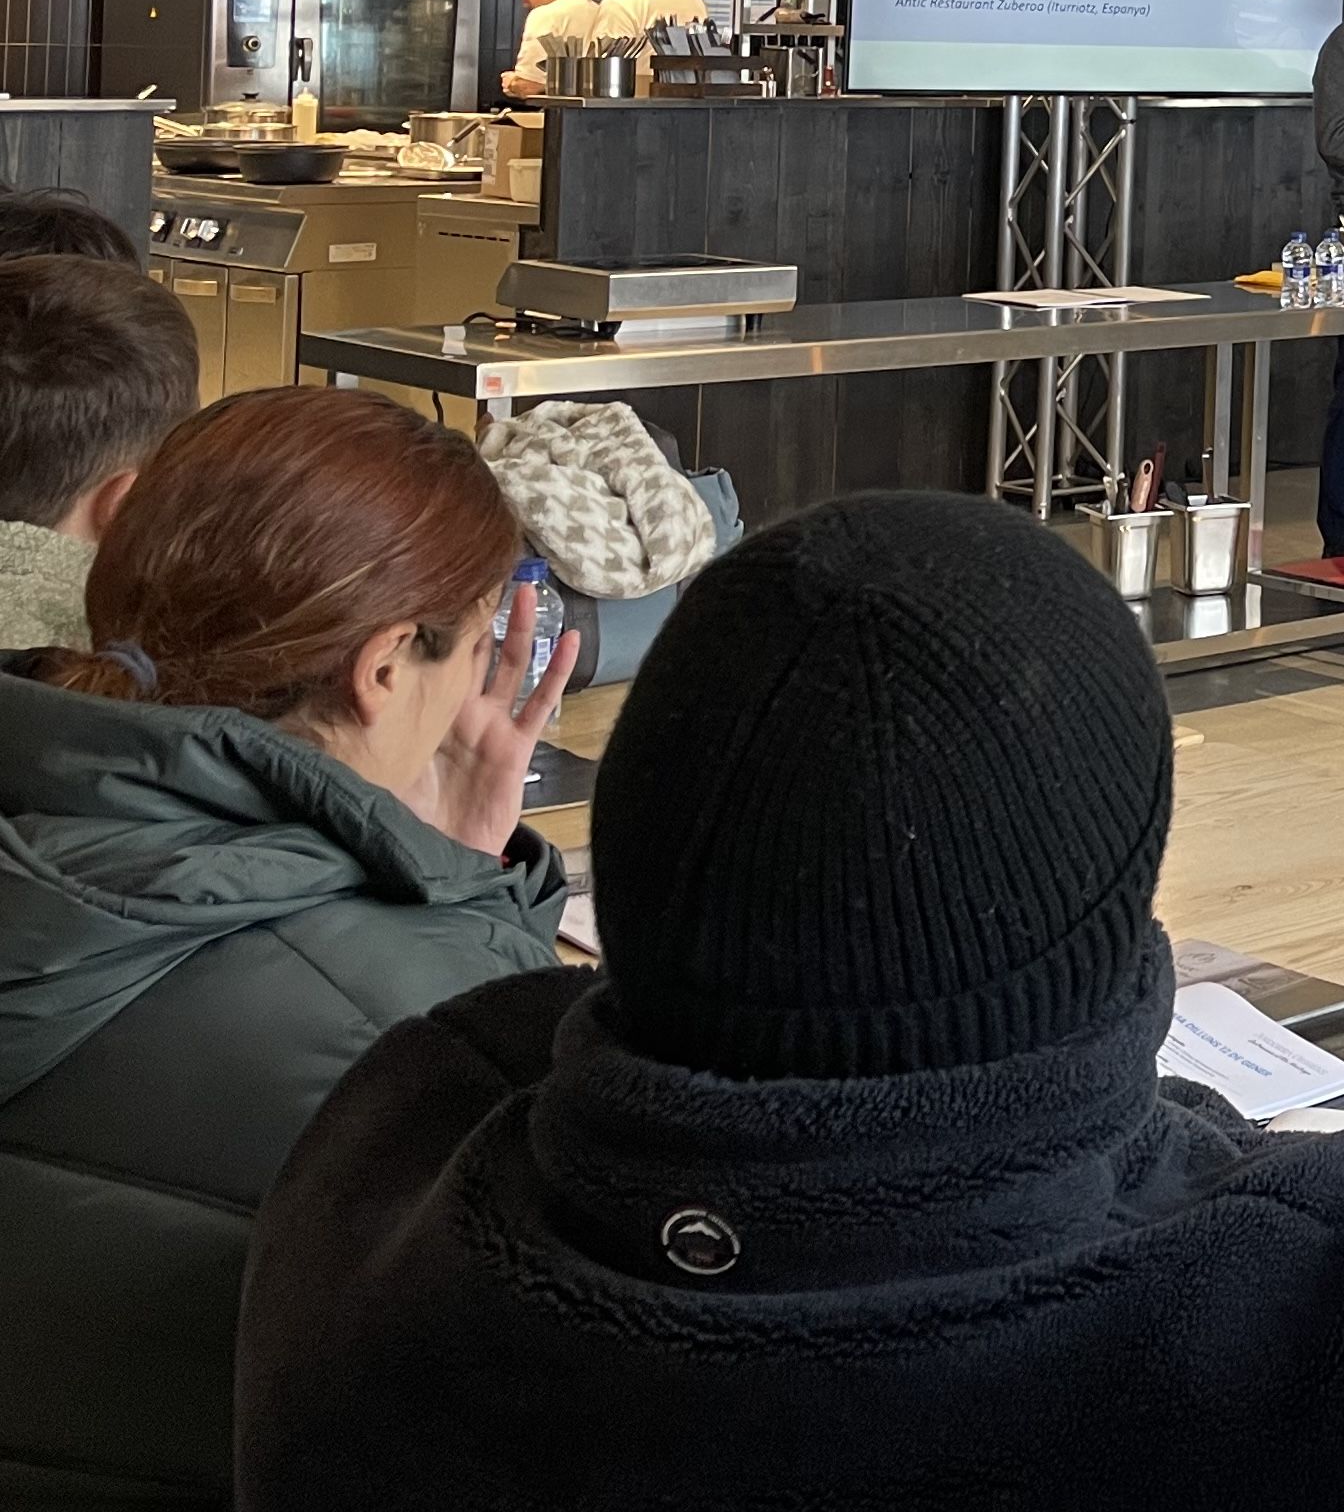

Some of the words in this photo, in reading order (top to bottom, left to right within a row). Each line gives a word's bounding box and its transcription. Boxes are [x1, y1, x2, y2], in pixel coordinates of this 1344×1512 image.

[996, 0, 1045, 12] Zuberoa
[1046, 0, 1099, 16] (Iturriotz,
[1101, 2, 1151, 17] Espanya)
